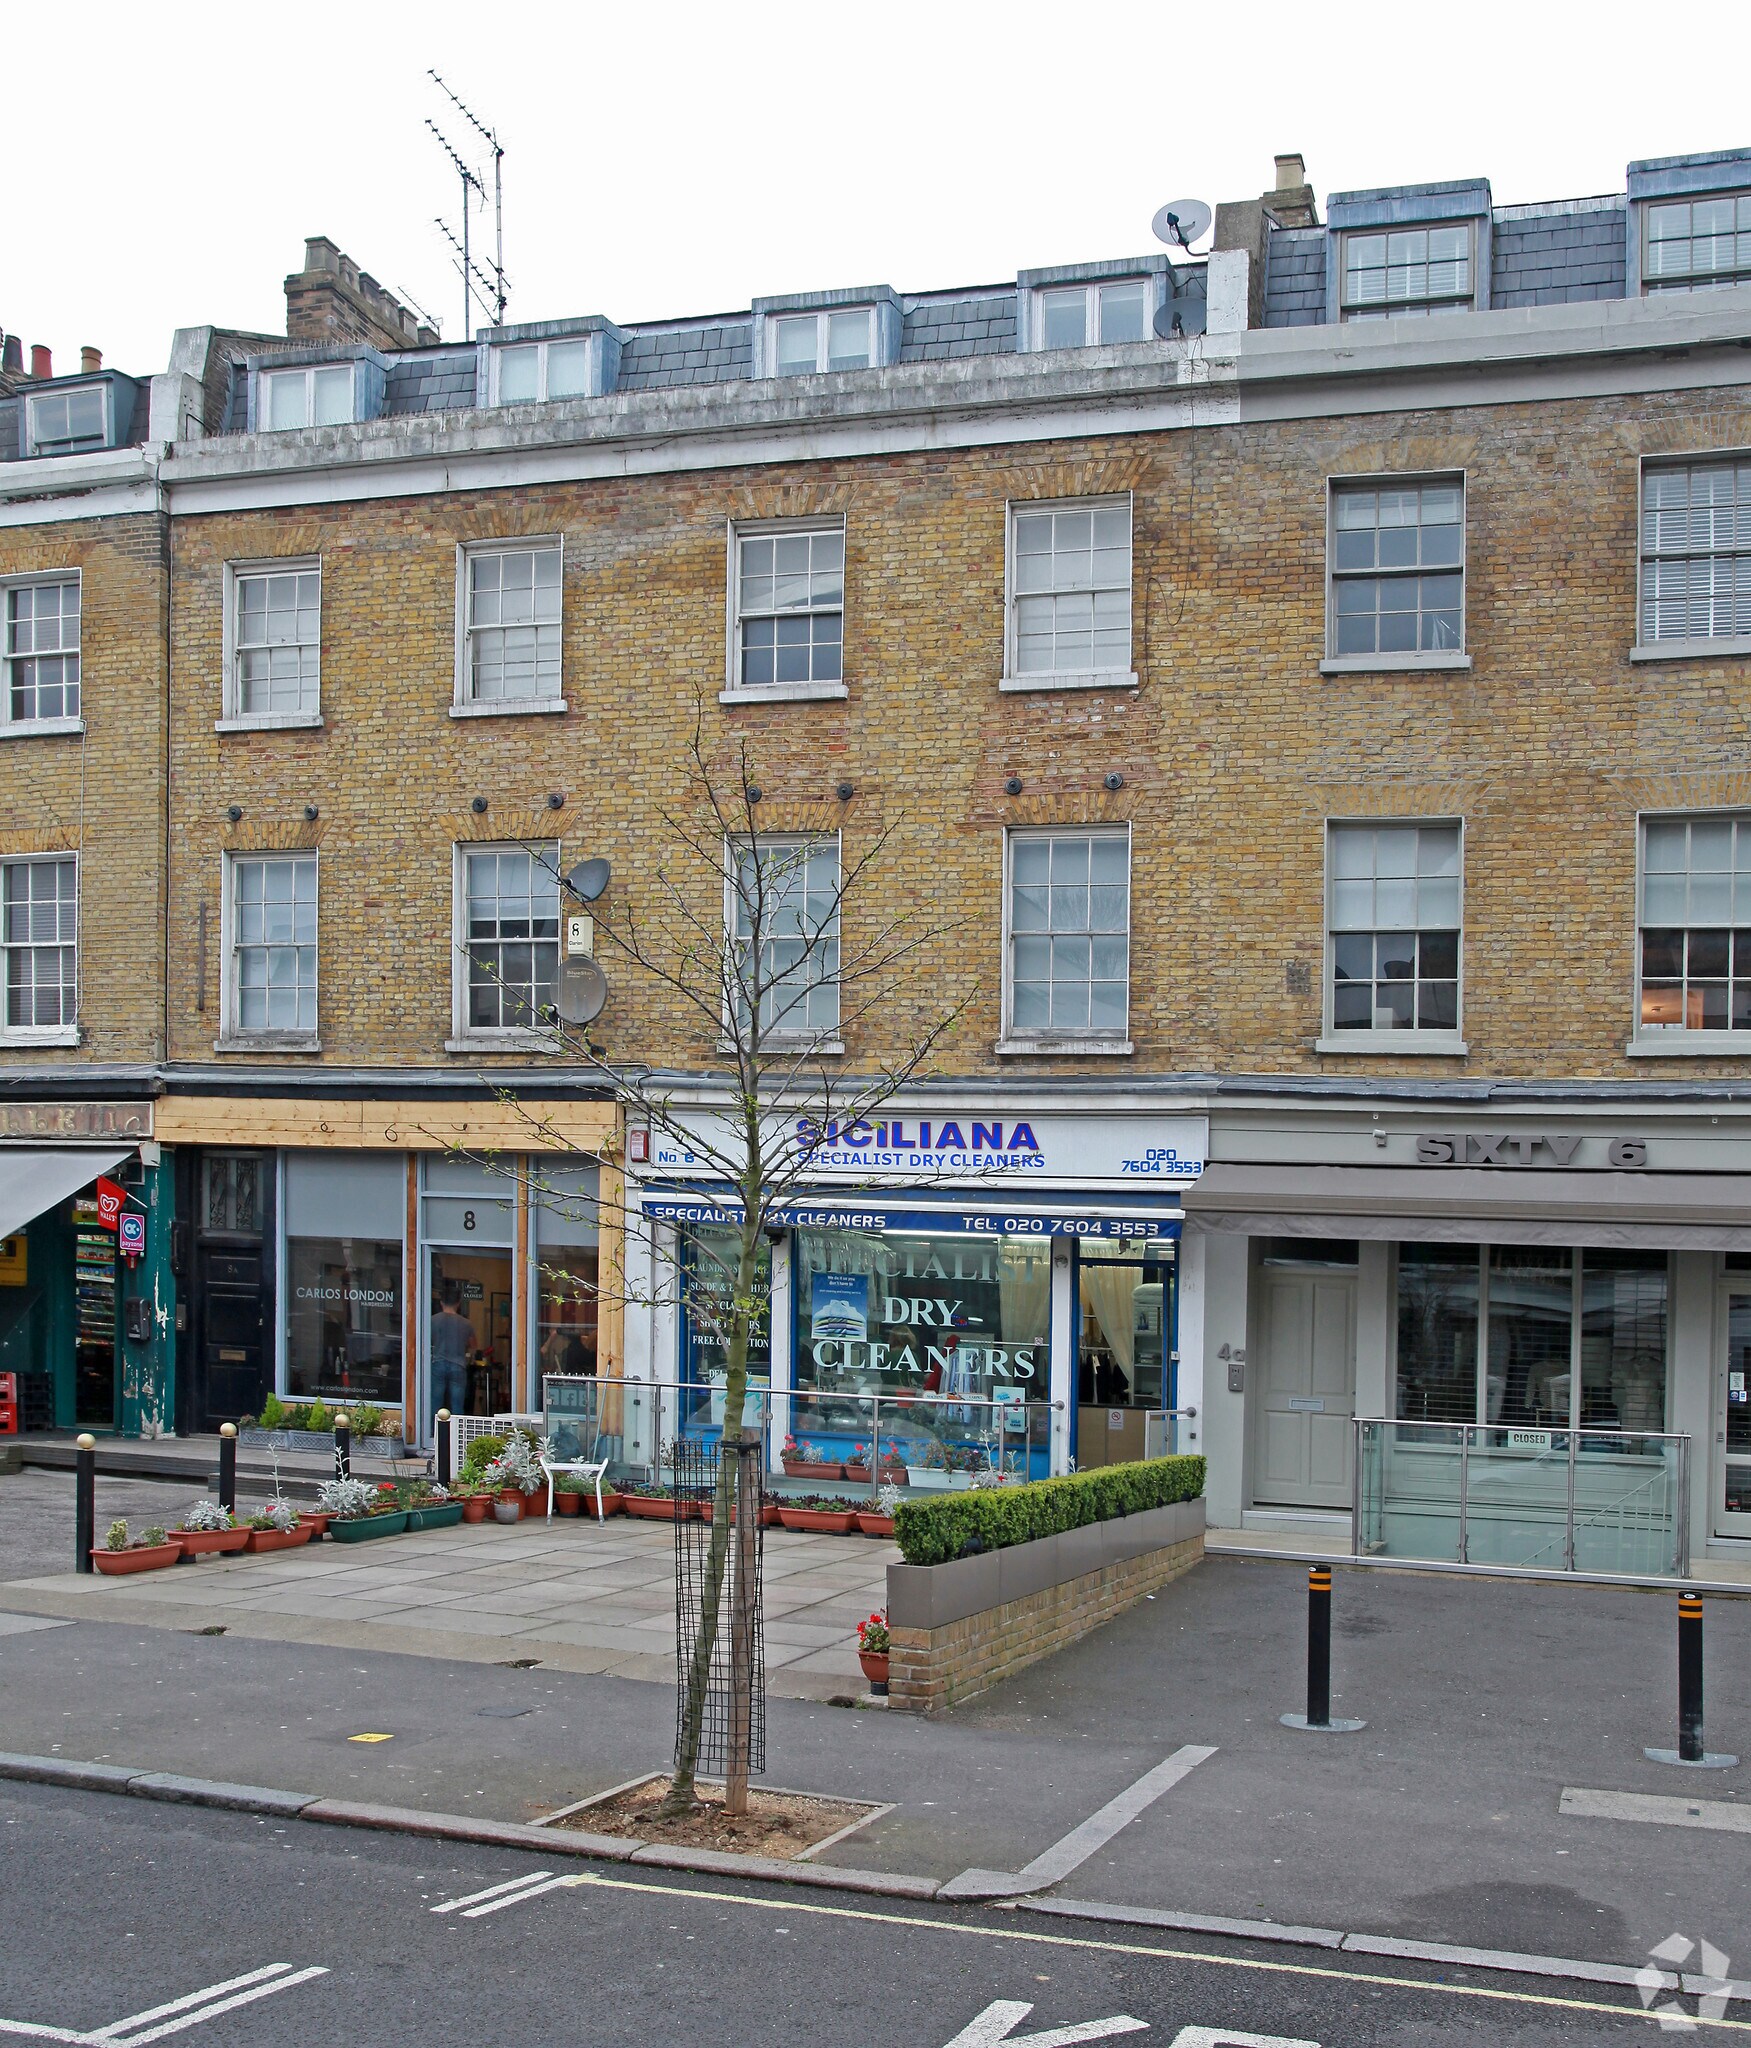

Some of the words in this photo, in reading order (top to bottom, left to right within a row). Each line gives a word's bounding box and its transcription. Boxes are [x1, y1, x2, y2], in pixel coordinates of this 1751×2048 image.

[796, 1118, 1040, 1150] SICILIANA
[1146, 1149, 1177, 1161] 020
[1416, 1133, 1583, 1165] SIXTY
[1608, 1136, 1647, 1166] 6
[797, 1152, 904, 1166] SPECIALIST
[909, 1154, 946, 1168] DRY
[949, 1154, 1046, 1168] CLEANERS
[1121, 1160, 1161, 1173] 7604
[1166, 1161, 1202, 1174] 3553
[463, 1210, 476, 1231] 8
[797, 1212, 886, 1228] CLEANERS
[962, 1217, 997, 1231] TEL:
[1004, 1218, 1044, 1232] 020
[1050, 1219, 1102, 1234] 7604
[1109, 1221, 1159, 1236] 3553
[296, 1287, 341, 1300] CARLOS
[344, 1289, 394, 1302] LONDON
[719, 1283, 727, 1292] &
[881, 1296, 964, 1327] DRY
[692, 1335, 715, 1345] FREE
[812, 1340, 1036, 1379] CLEANERS
[1217, 1343, 1246, 1361] 4a
[1513, 1433, 1546, 1444] CLOSED
